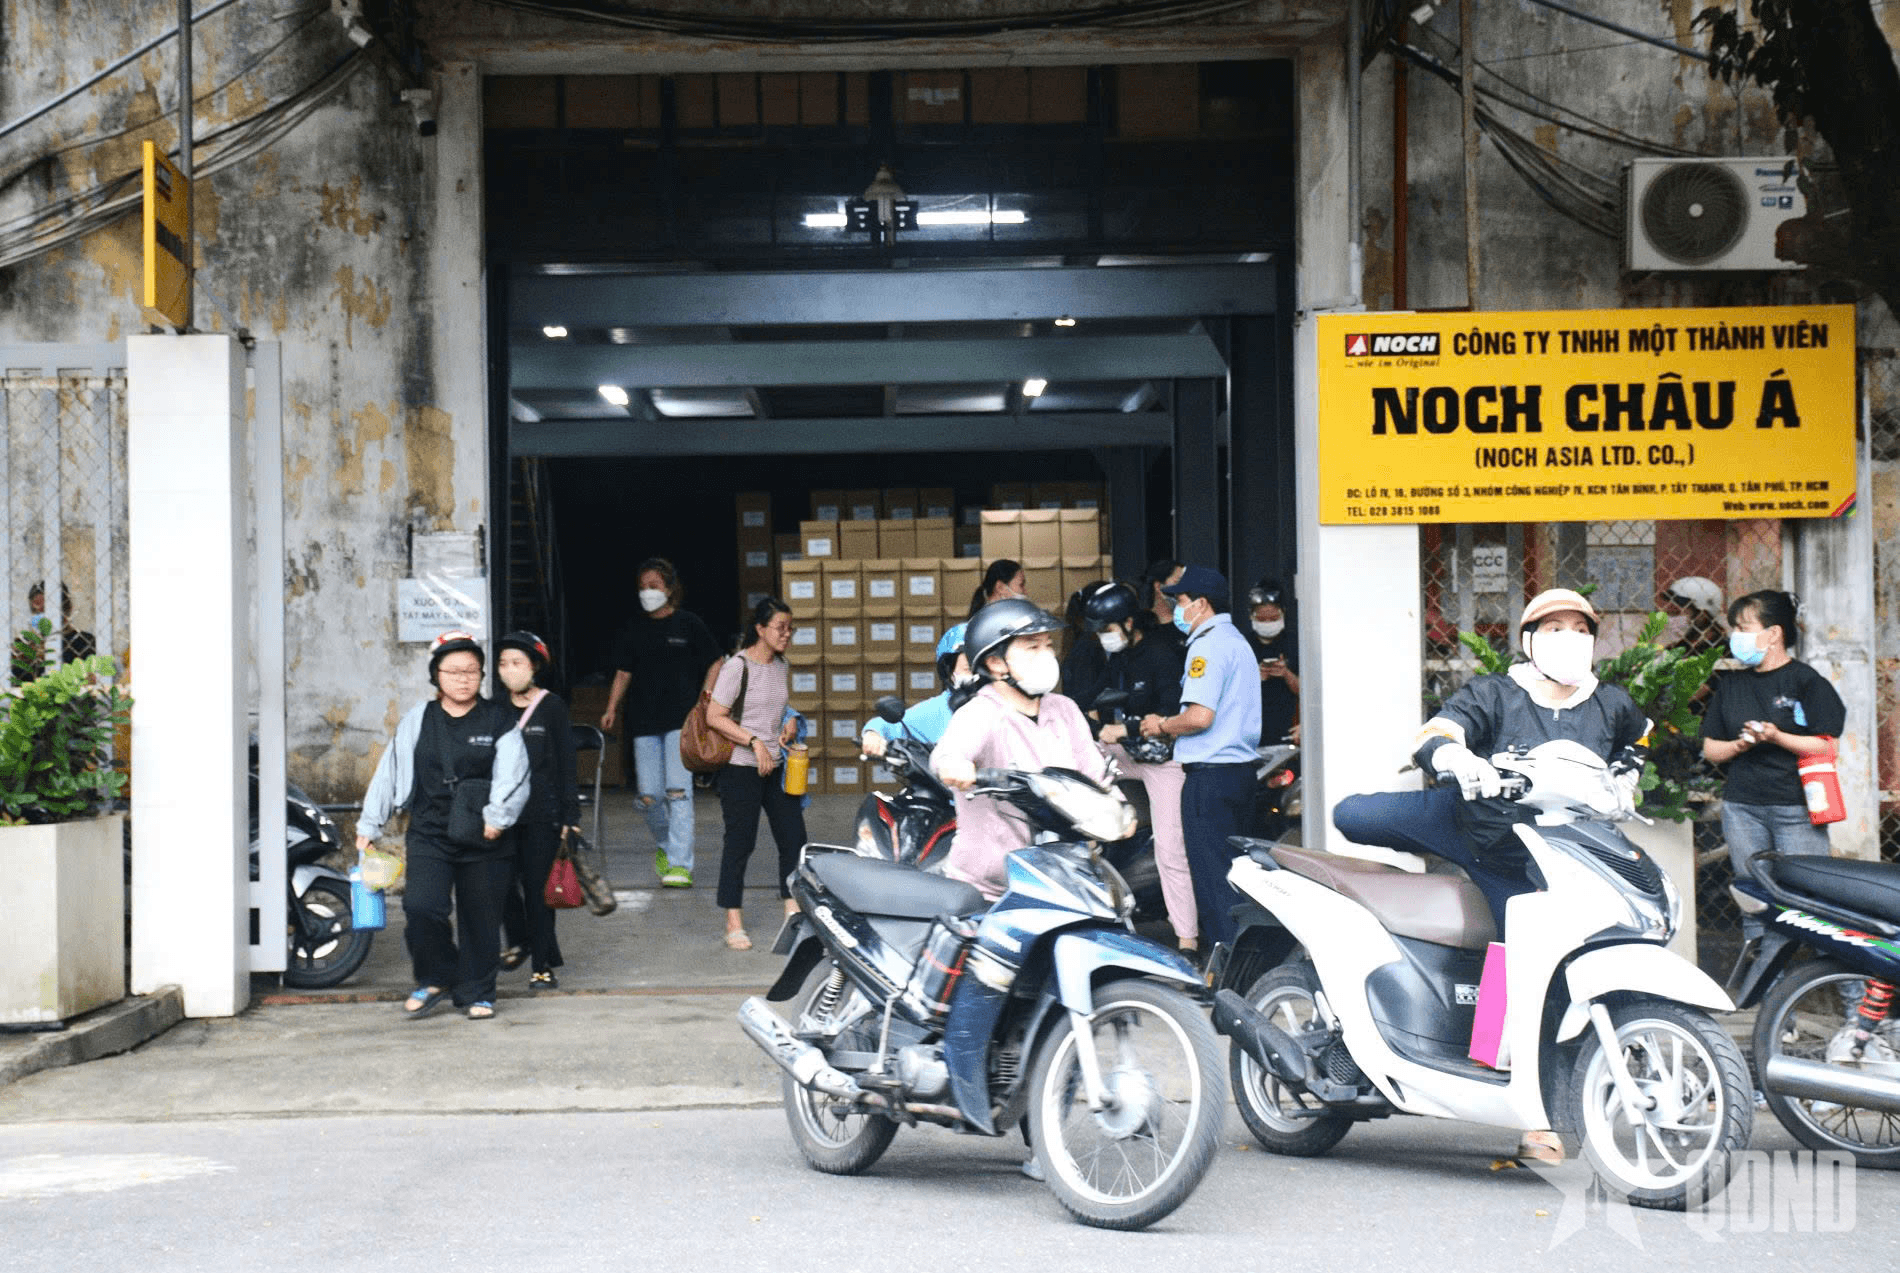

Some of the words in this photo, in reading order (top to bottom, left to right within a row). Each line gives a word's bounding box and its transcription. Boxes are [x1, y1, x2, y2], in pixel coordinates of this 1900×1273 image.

[1373, 336, 1437, 352] NOCH
[1453, 326, 1516, 355] CÔNG
[1524, 331, 1550, 354] TY
[1559, 330, 1619, 353] TNHH
[1628, 323, 1678, 356] MỘT
[1686, 321, 1765, 351] THÀNH
[1772, 320, 1828, 349] VIÊN
[1371, 385, 1542, 435] NOCH
[1565, 371, 1736, 432] CHÂU
[1755, 368, 1800, 429] Á
[1475, 445, 1537, 469] (NOCH
[1545, 445, 1594, 467] ASIA
[1601, 445, 1641, 466] LTD.
[1369, 506, 1387, 516] 028
